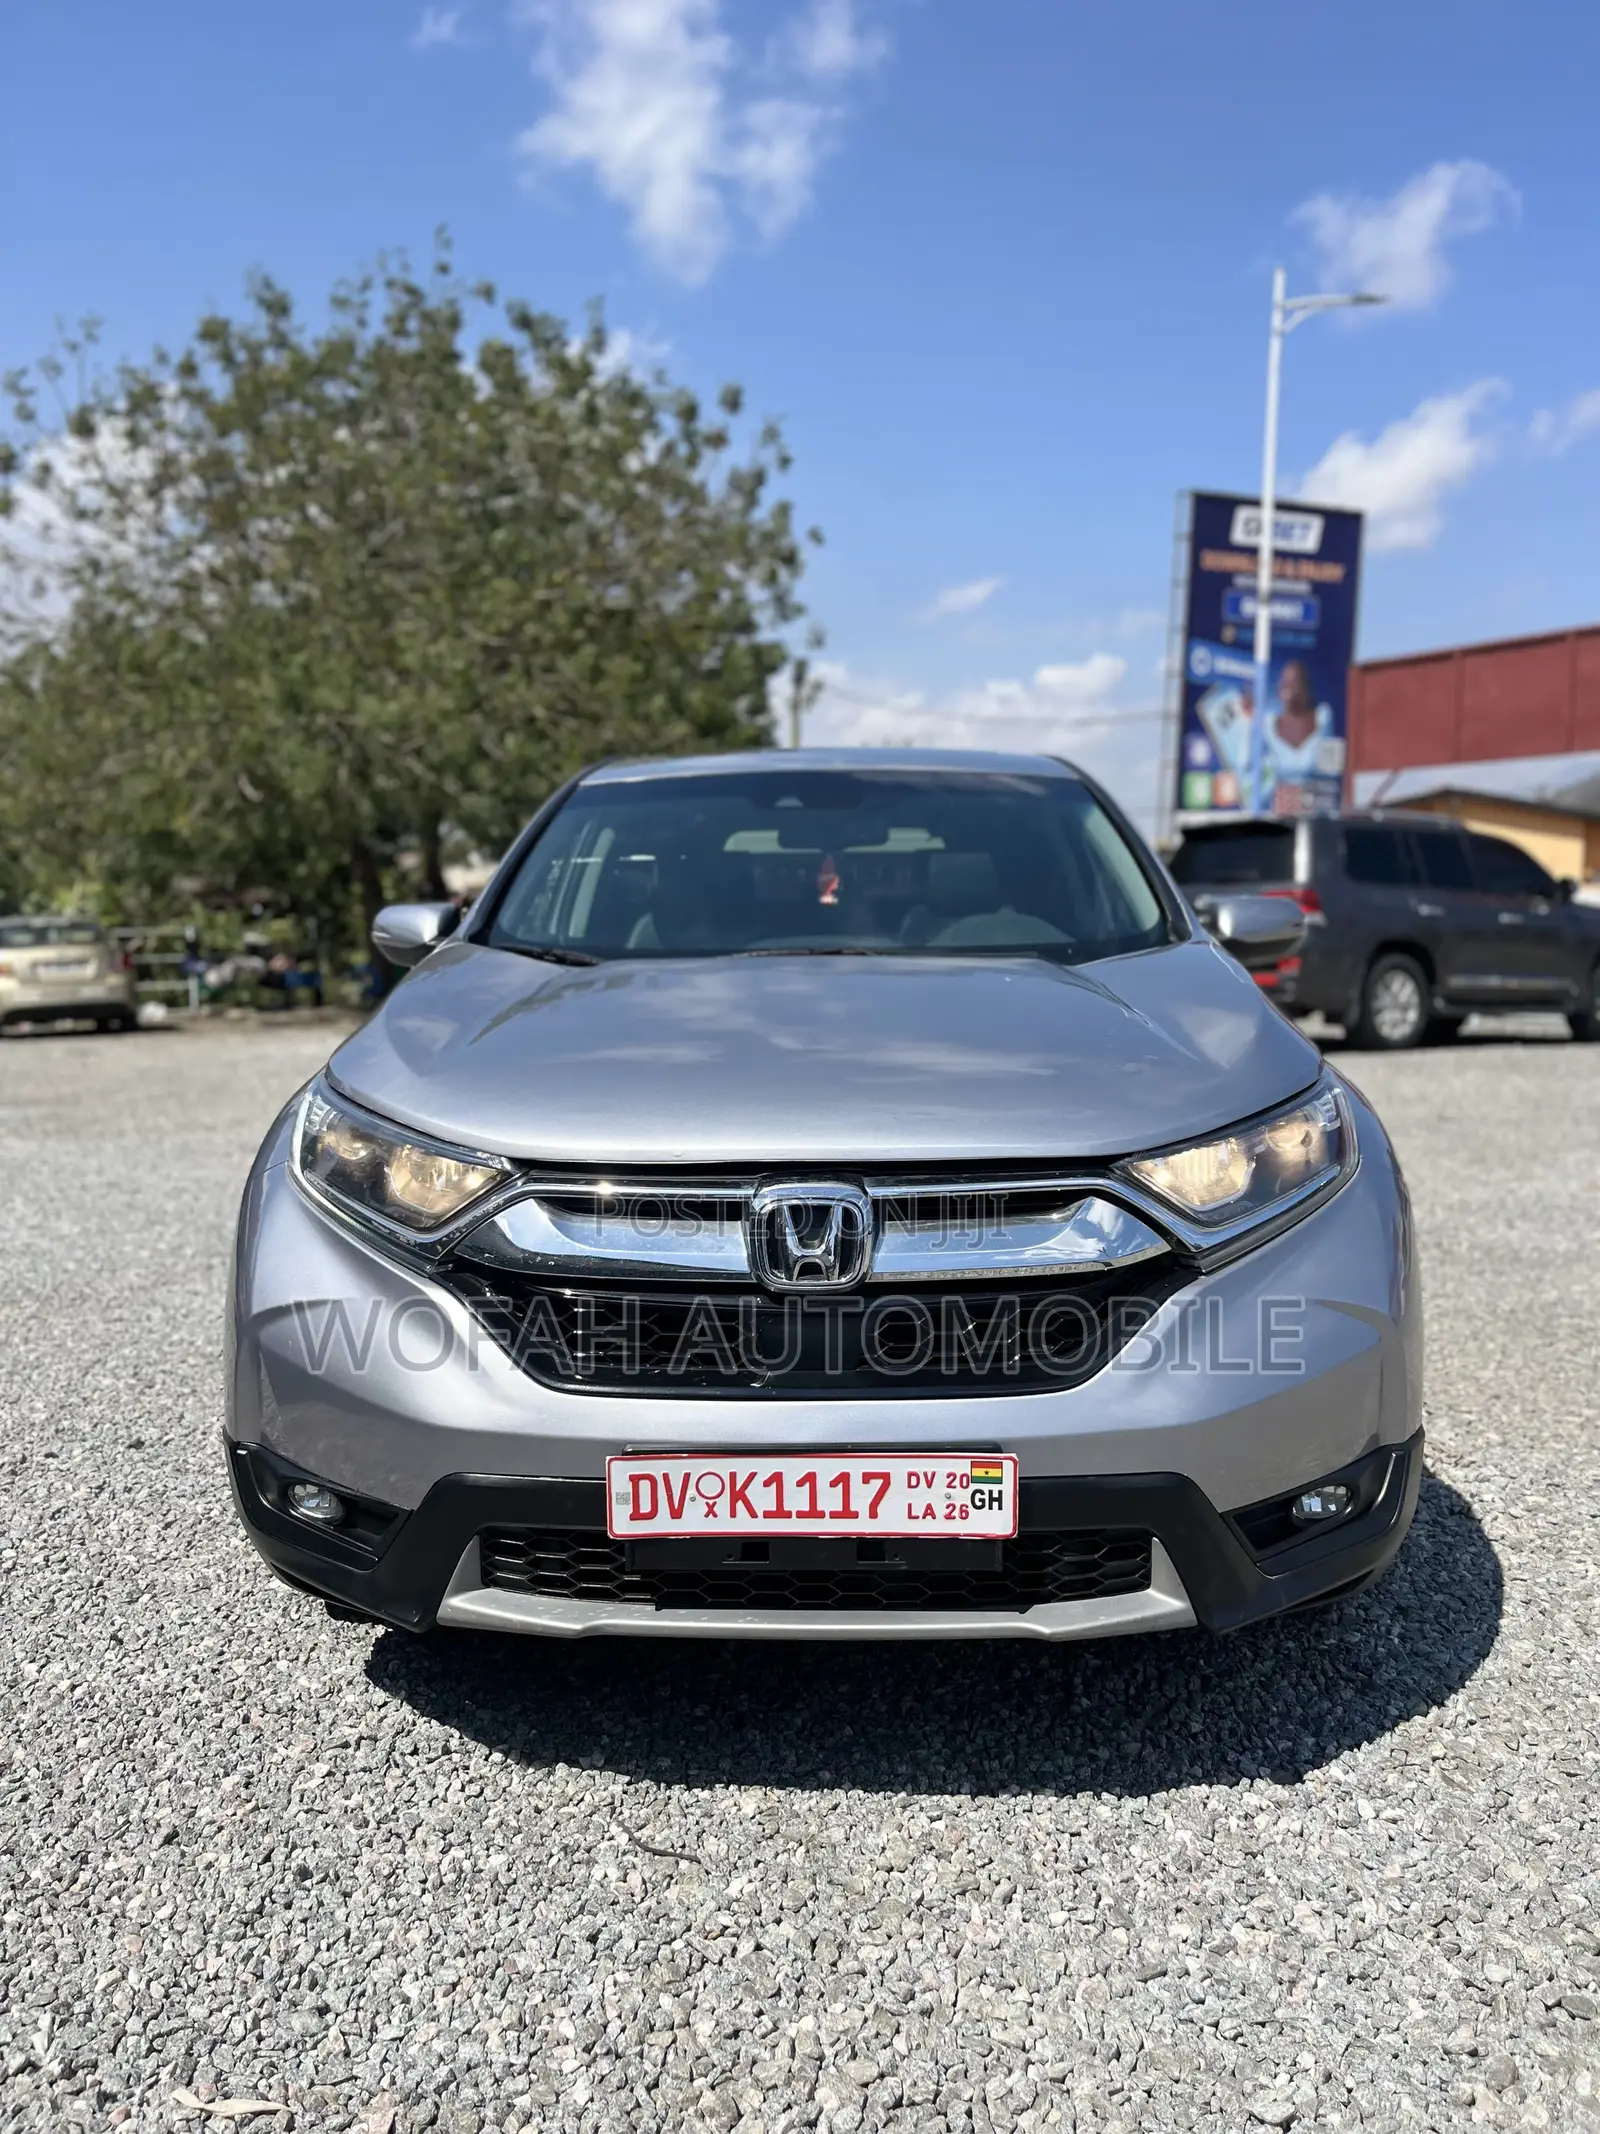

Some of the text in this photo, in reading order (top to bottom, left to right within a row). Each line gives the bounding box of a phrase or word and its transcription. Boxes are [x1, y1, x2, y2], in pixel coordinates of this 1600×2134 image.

[906, 1471, 970, 1489] DV 20
[628, 1472, 691, 1521] DV
[729, 1471, 891, 1519] K1117
[970, 1488, 1003, 1511] GH
[906, 1502, 970, 1520] LA 26
